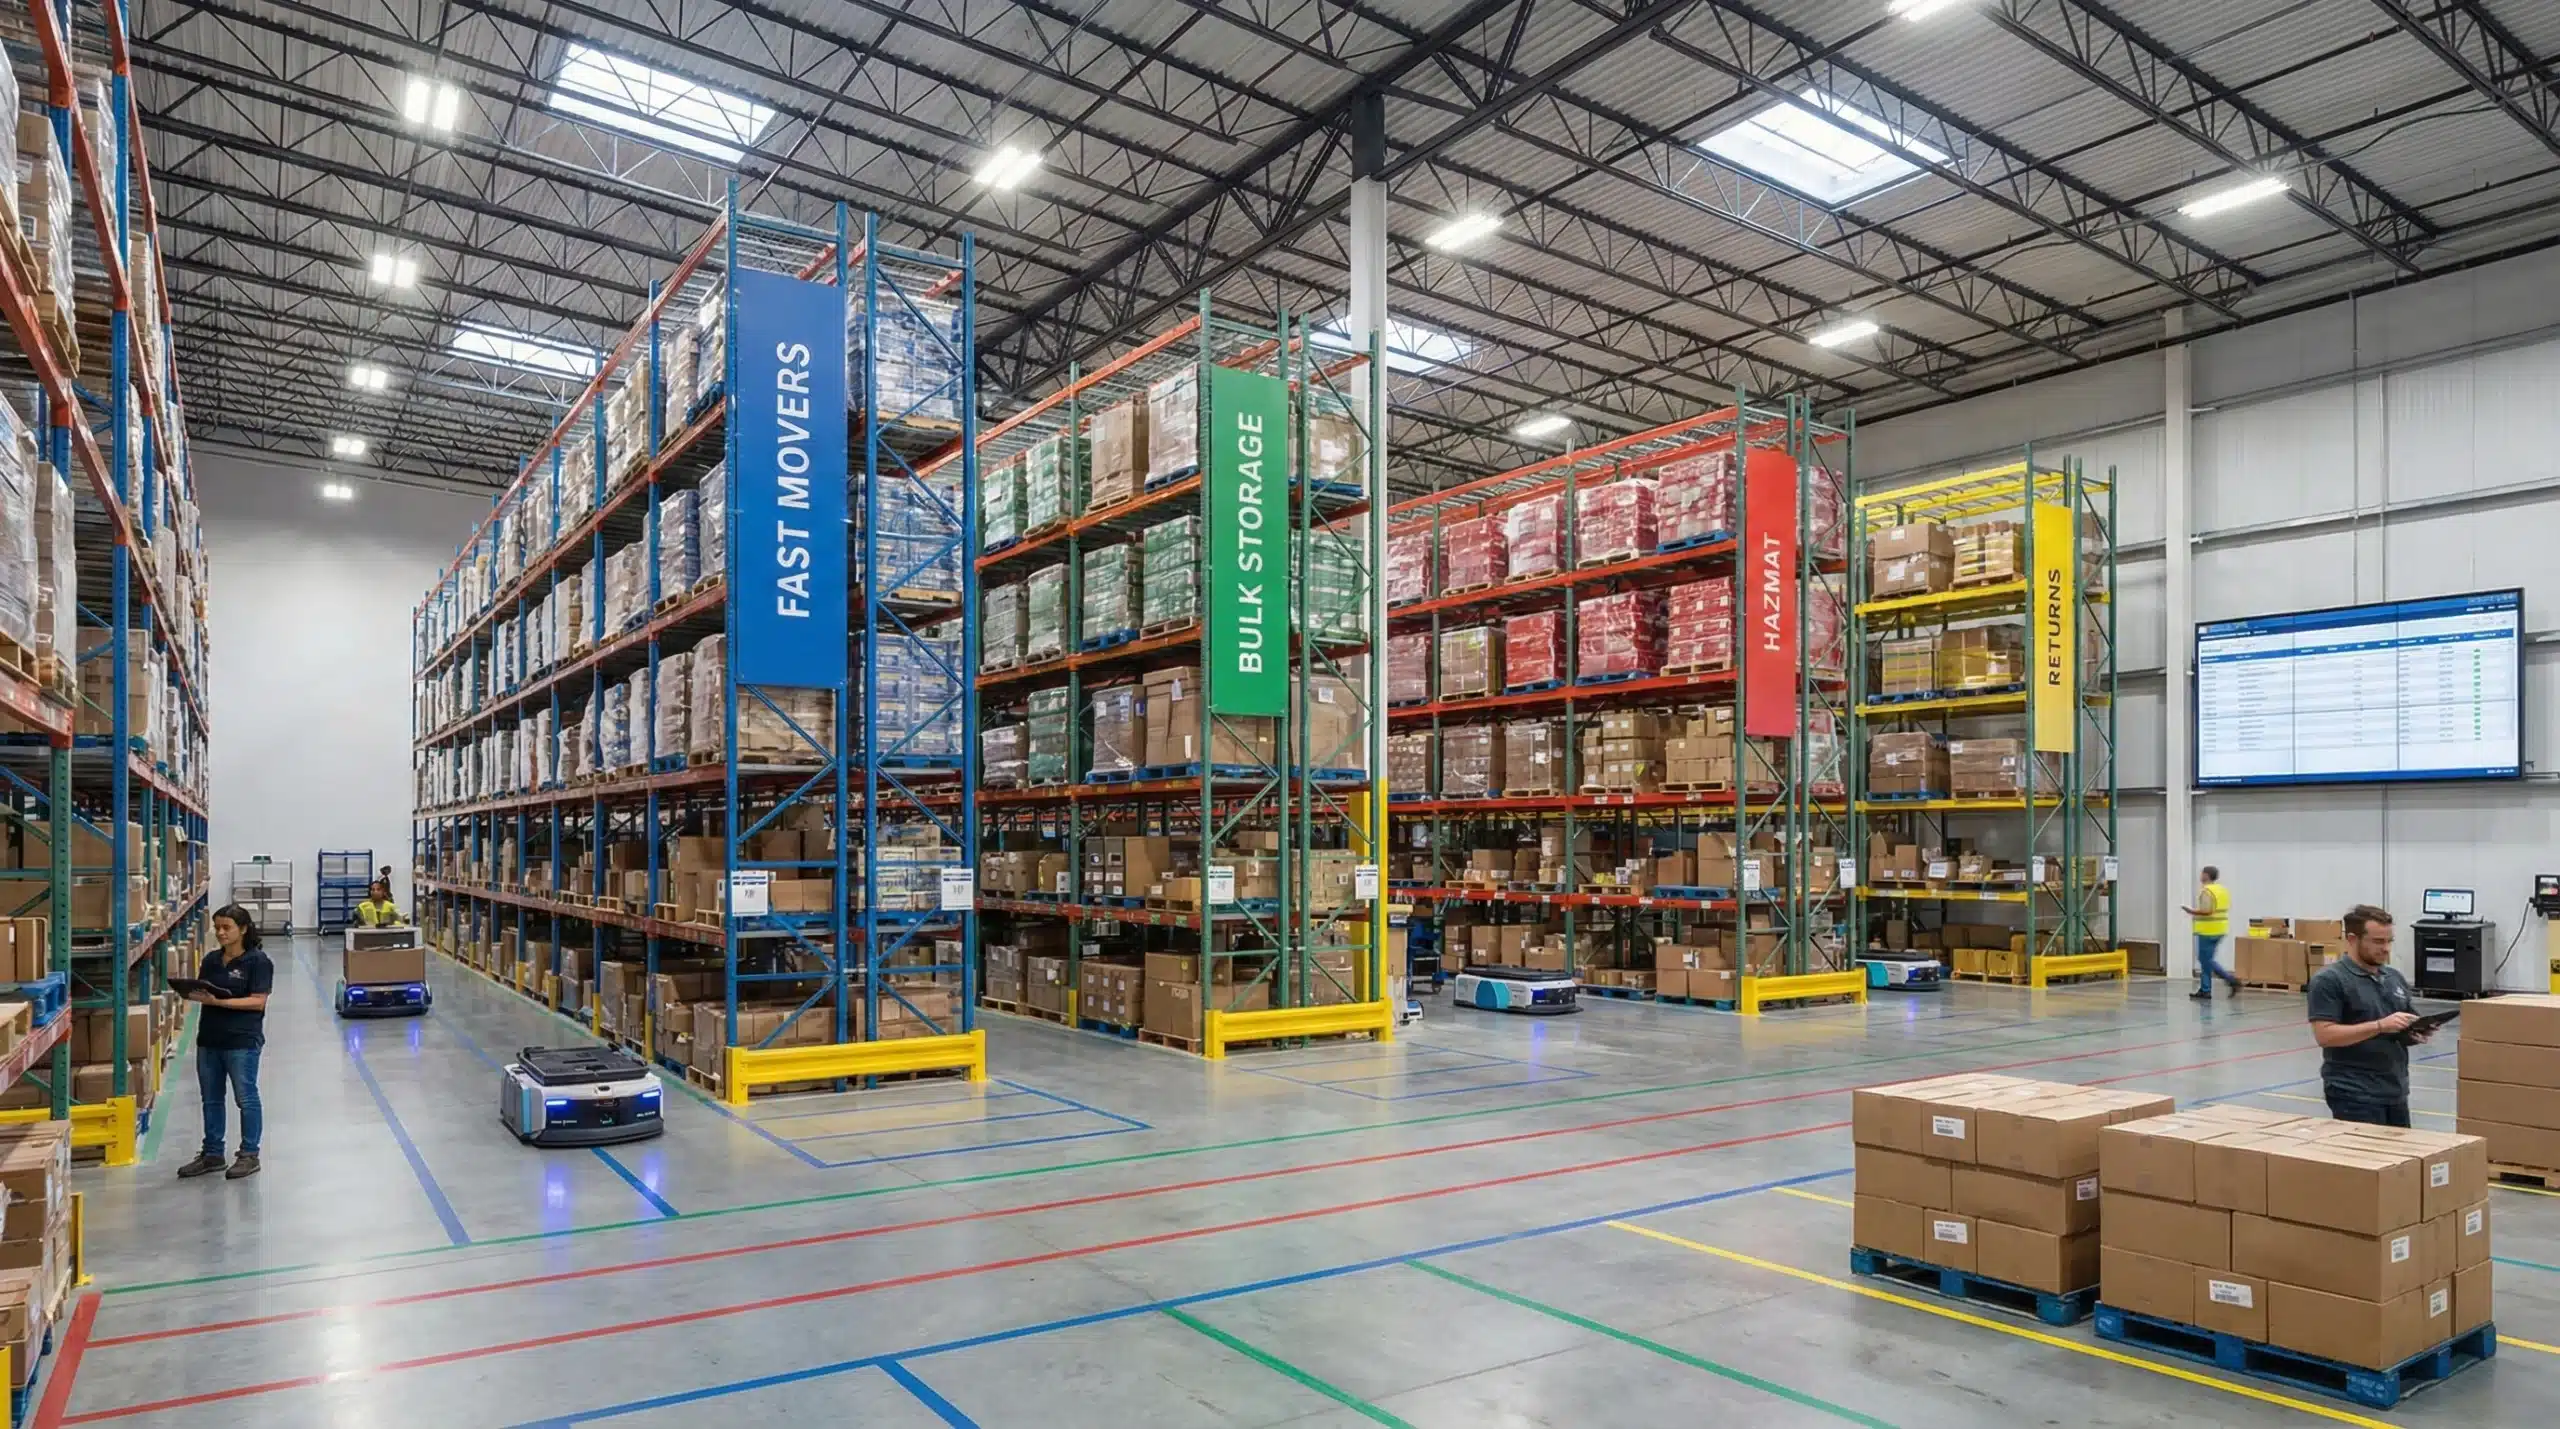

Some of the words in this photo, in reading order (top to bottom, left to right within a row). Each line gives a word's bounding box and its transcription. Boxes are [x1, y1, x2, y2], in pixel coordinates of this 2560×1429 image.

[776, 342, 810, 510] MOVERS
[1238, 412, 1263, 573] STORAGE
[776, 520, 810, 617] FAST
[1763, 532, 1781, 651] HAZMAT
[2047, 568, 2061, 686] RETURNS
[1238, 583, 1263, 673] BULK
